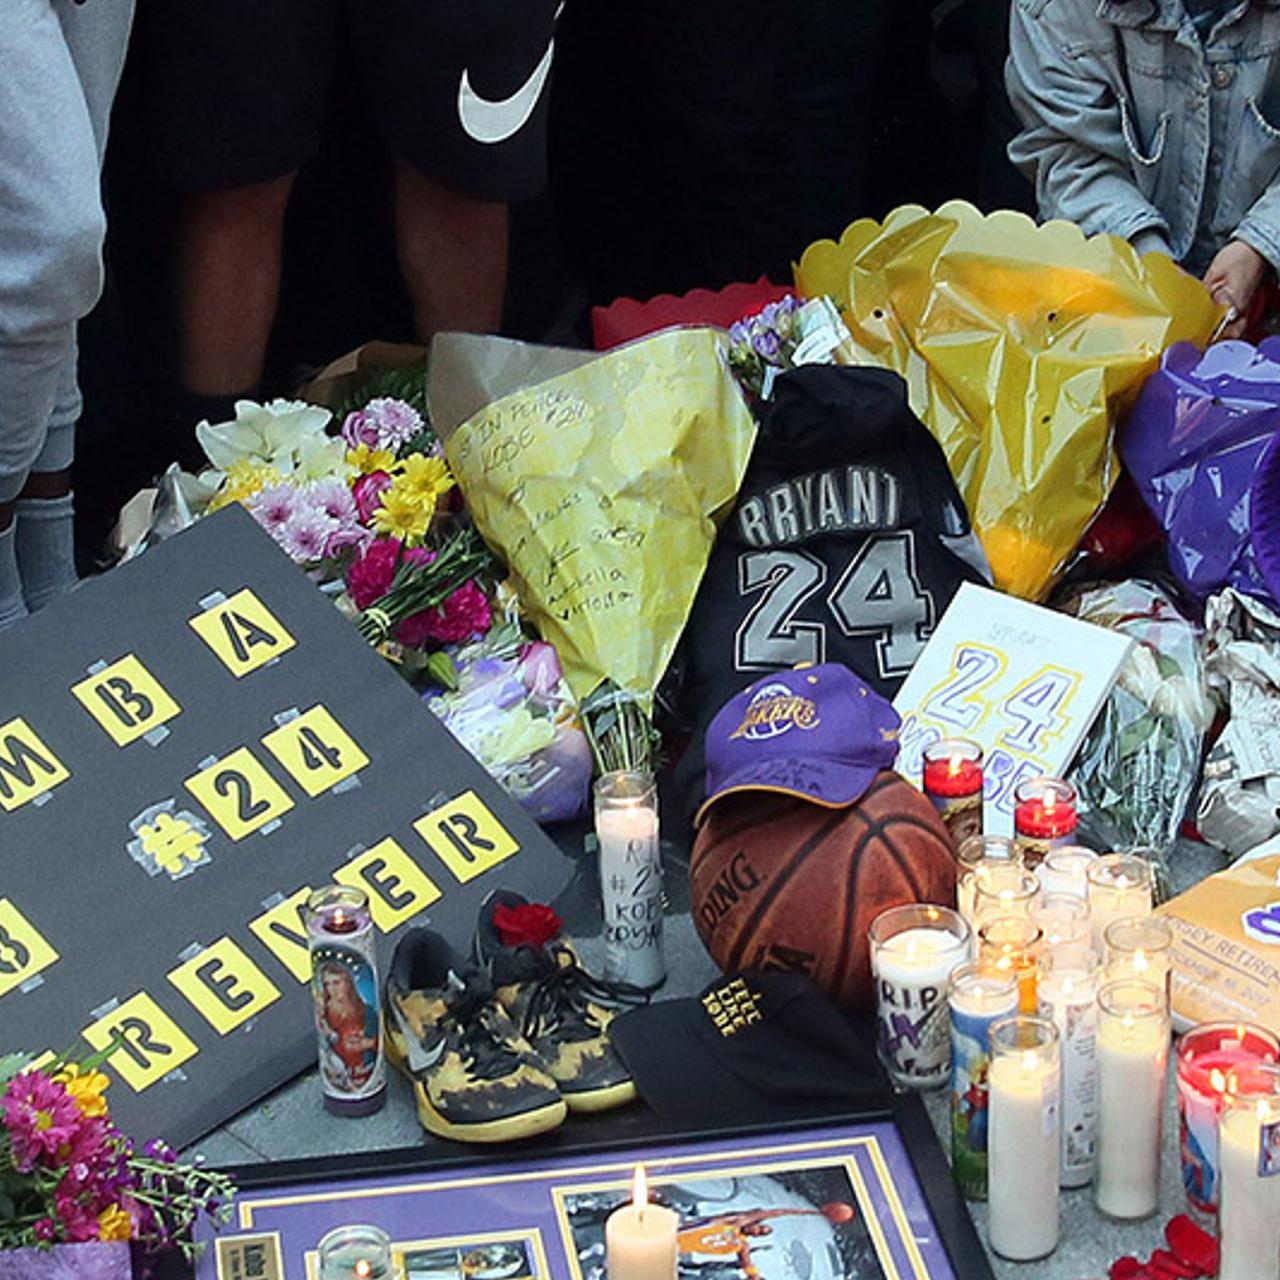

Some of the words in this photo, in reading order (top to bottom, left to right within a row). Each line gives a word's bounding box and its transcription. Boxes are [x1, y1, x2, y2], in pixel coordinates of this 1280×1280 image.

[738, 466, 900, 548] BRYANT
[735, 529, 937, 679] 24
[922, 642, 1082, 754] 24
[135, 724, 347, 875] #24
